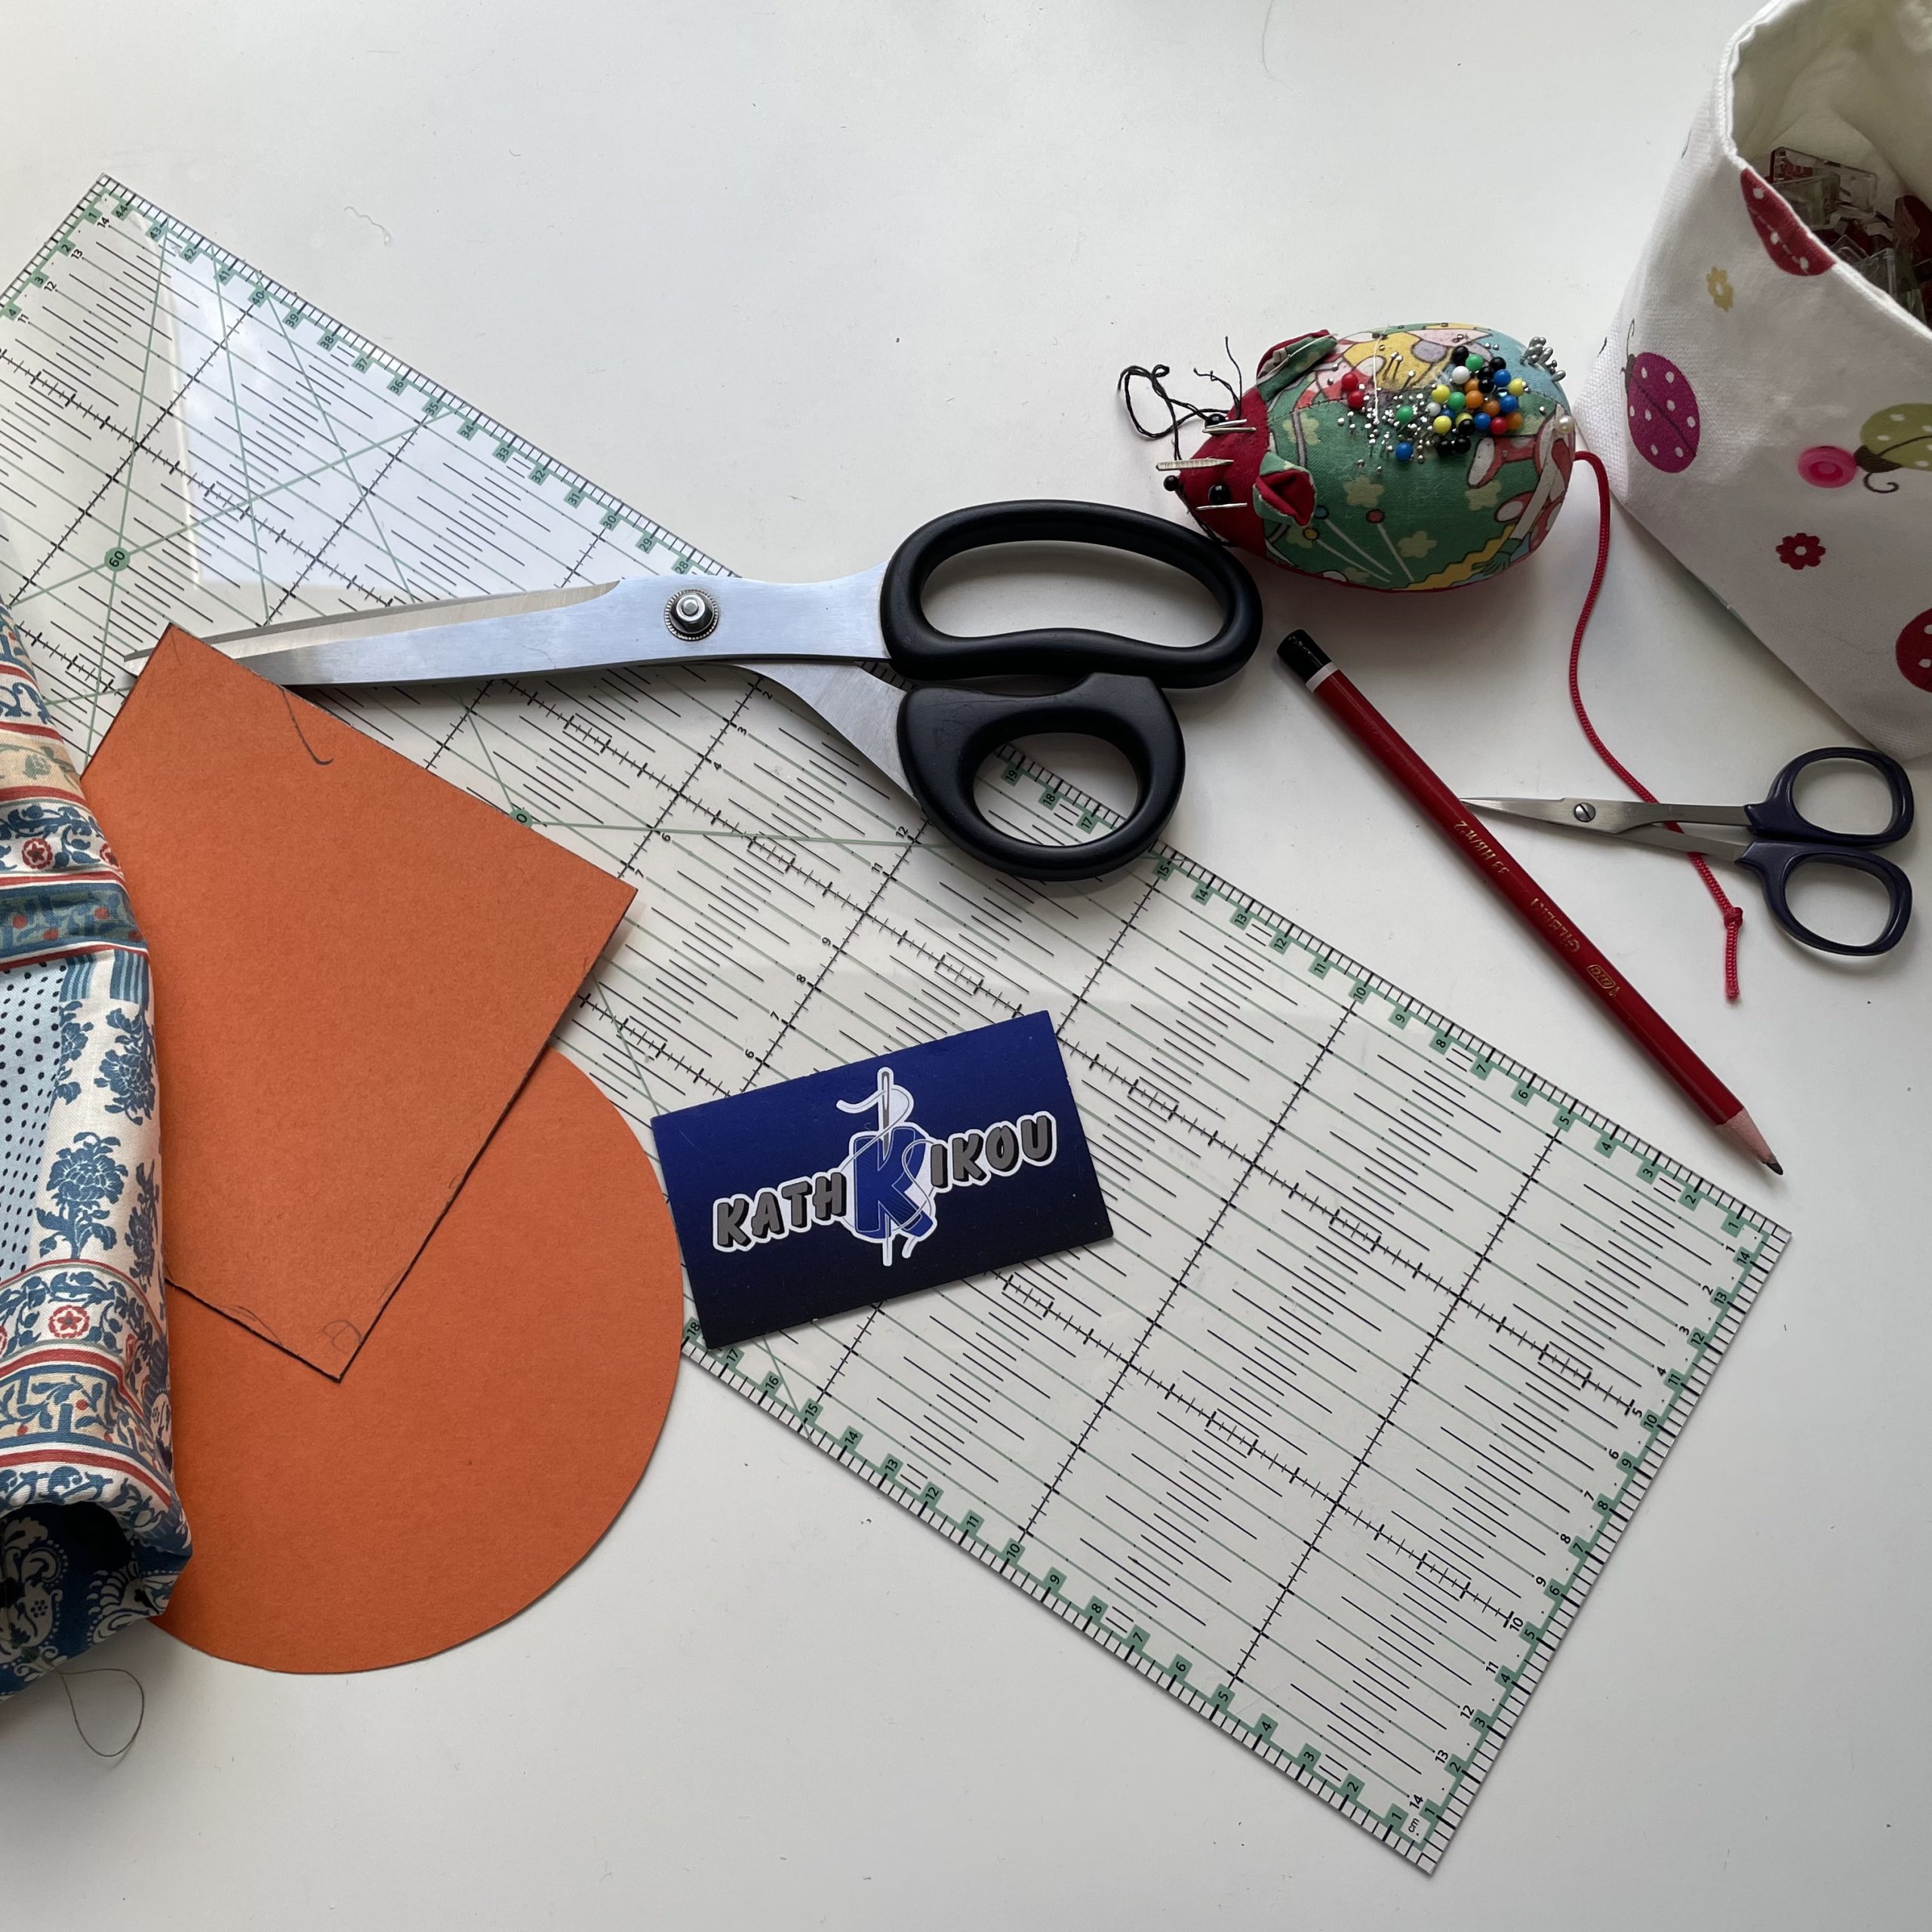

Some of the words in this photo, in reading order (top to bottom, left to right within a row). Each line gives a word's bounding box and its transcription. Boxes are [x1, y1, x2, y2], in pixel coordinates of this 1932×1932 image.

[17, 313, 29, 324] 11
[44, 281, 57, 292] 12
[70, 248, 83, 260] 13
[97, 217, 109, 228] 14
[109, 550, 125, 568] 60
[761, 691, 774, 700] 2
[115, 205, 128, 218] 44
[149, 226, 162, 240] 43
[183, 248, 197, 261] 42
[218, 270, 230, 281] 41
[251, 290, 265, 305] 40
[285, 313, 299, 328] 39
[319, 335, 334, 349] 38
[355, 357, 368, 371] 37
[389, 380, 404, 394] 36
[425, 402, 438, 416] 35
[460, 425, 475, 438] 34
[496, 448, 509, 461] 33
[531, 469, 546, 484] 32
[567, 493, 580, 506] 31
[602, 515, 617, 530] 30
[638, 538, 653, 553] 29
[675, 561, 689, 574] 28
[1004, 769, 1018, 782] 19
[1042, 793, 1056, 805] 18
[1080, 816, 1093, 829] 17
[1157, 864, 1169, 876] 15
[1195, 888, 1209, 901] 14
[1234, 913, 1247, 925] 13
[1273, 937, 1287, 950] 12
[1314, 962, 1326, 974] 11
[1353, 986, 1367, 1000] 10
[1395, 1014, 1406, 1024] 9
[1435, 1038, 1447, 1049] 8
[1475, 1063, 1487, 1074] 7
[1518, 1089, 1529, 1100] 6
[1558, 1115, 1571, 1126] 5
[1601, 1142, 1613, 1152] 4
[1642, 1168, 1654, 1179] 3
[1684, 1194, 1697, 1205] 2
[737, 726, 748, 737] 3
[713, 761, 723, 771] 4
[661, 832, 672, 842] 6
[896, 826, 909, 838] 12
[871, 862, 883, 873] 11
[635, 869, 645, 879] 7
[822, 937, 832, 947] 9
[796, 974, 808, 984] 8
[770, 1011, 780, 1022] 7
[745, 1048, 755, 1060] 6
[1737, 1251, 1750, 1264] 14
[1702, 1284, 1715, 1297] 2
[1714, 1291, 1727, 1305] 13
[1678, 1325, 1690, 1337] 3
[1690, 1332, 1705, 1346] 12
[1657, 1366, 1668, 1377] 4
[1668, 1374, 1681, 1386] 11
[1632, 1407, 1644, 1419] 5
[1643, 1414, 1657, 1429] 10
[1608, 1448, 1620, 1460] 6
[1621, 1458, 1633, 1469] 9
[1583, 1491, 1595, 1502] 7
[1598, 1500, 1609, 1512] 8
[1560, 1534, 1572, 1546] 8
[1572, 1542, 1584, 1553] 7
[686, 1321, 700, 1336] 18
[725, 1348, 739, 1362] 17
[764, 1375, 779, 1389] 16
[804, 1402, 818, 1417] 15
[844, 1431, 858, 1445] 14
[884, 1459, 898, 1472] 13
[924, 1487, 940, 1500] 12
[966, 1515, 980, 1528] 11
[1006, 1543, 1020, 1558] 10
[1050, 1574, 1061, 1586] 9
[1091, 1603, 1103, 1614] 8
[1132, 1631, 1144, 1644] 7
[1175, 1661, 1187, 1672] 6
[1217, 1690, 1229, 1703] 5
[1261, 1721, 1272, 1733] 4
[1303, 1751, 1315, 1763] 3
[1346, 1781, 1360, 1793] 2
[1536, 1577, 1547, 1588] 9
[1549, 1585, 1561, 1597] 6
[1509, 1617, 1524, 1632] 10
[1524, 1629, 1536, 1641] 5
[1485, 1661, 1499, 1674] 11
[1500, 1673, 1512, 1684] 4
[1460, 1705, 1475, 1719] 12
[1474, 1717, 1487, 1728] 3
[1435, 1749, 1448, 1764] 13
[1449, 1761, 1463, 1774] 2
[1409, 1794, 1424, 1809] 14
[1407, 1818, 1420, 1833] cm
